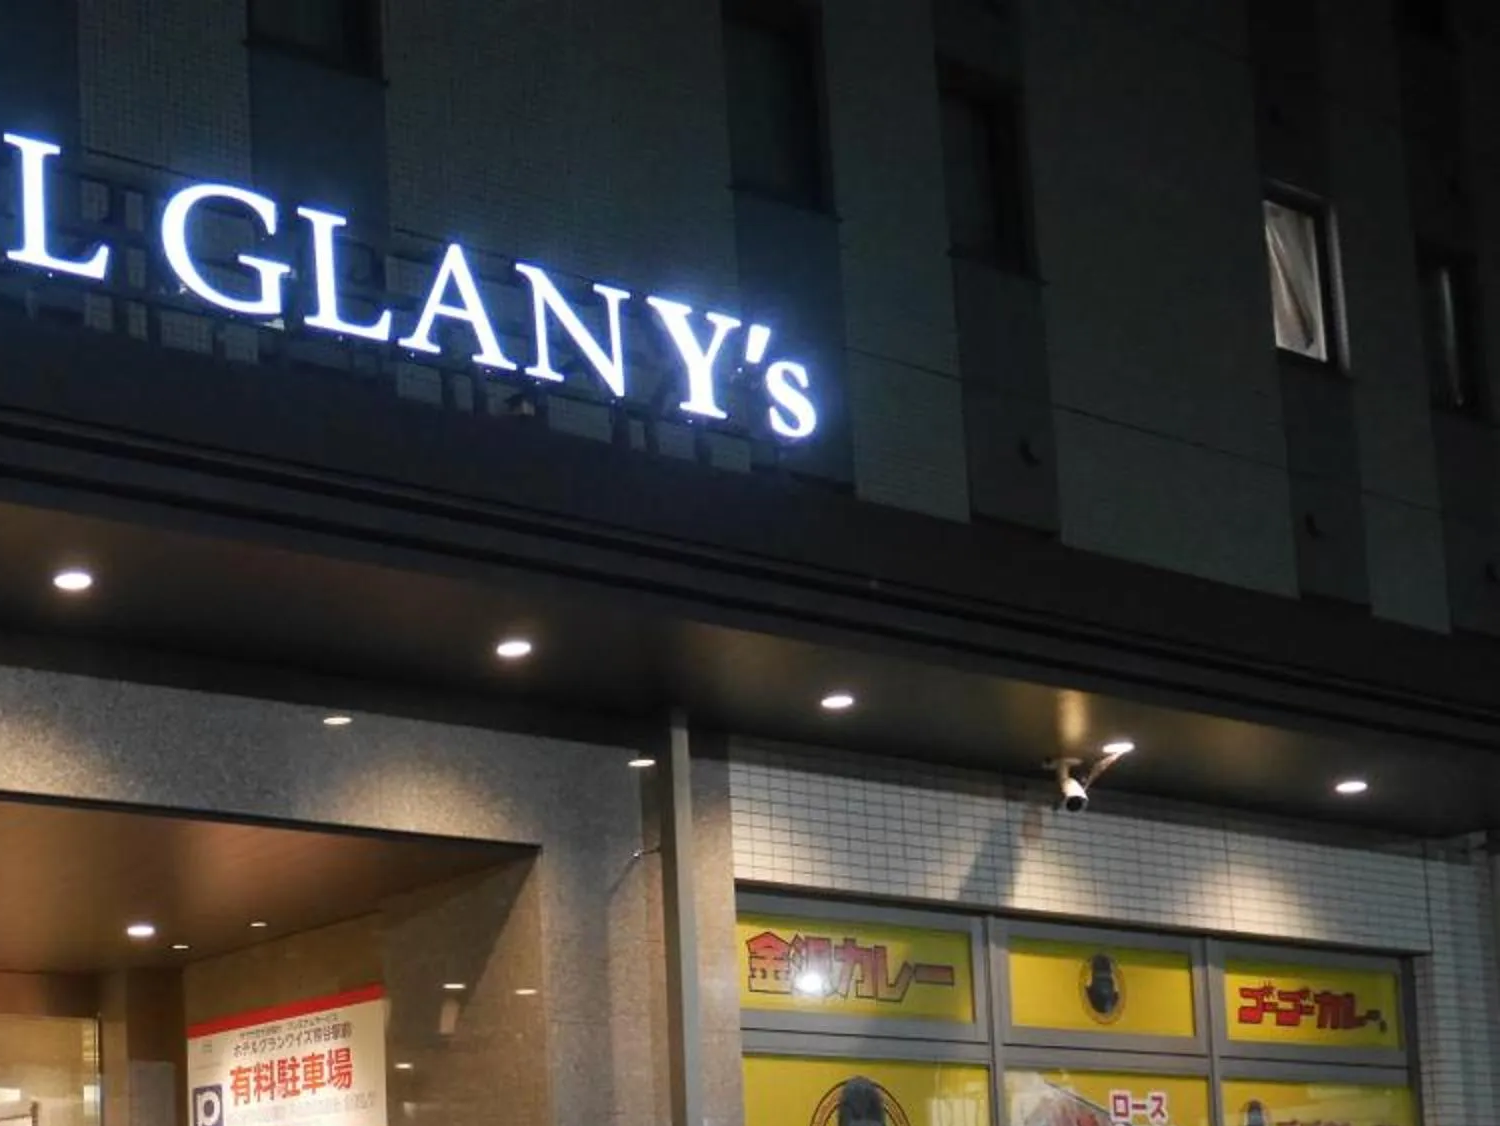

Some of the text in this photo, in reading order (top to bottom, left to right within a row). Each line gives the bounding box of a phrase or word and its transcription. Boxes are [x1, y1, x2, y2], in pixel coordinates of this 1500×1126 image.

[161, 182, 818, 438] GLANY's
[746, 931, 955, 1002] 金沢カレー
[230, 1048, 353, 1107] 有料駐車場
[1112, 1095, 1165, 1119] ロース
